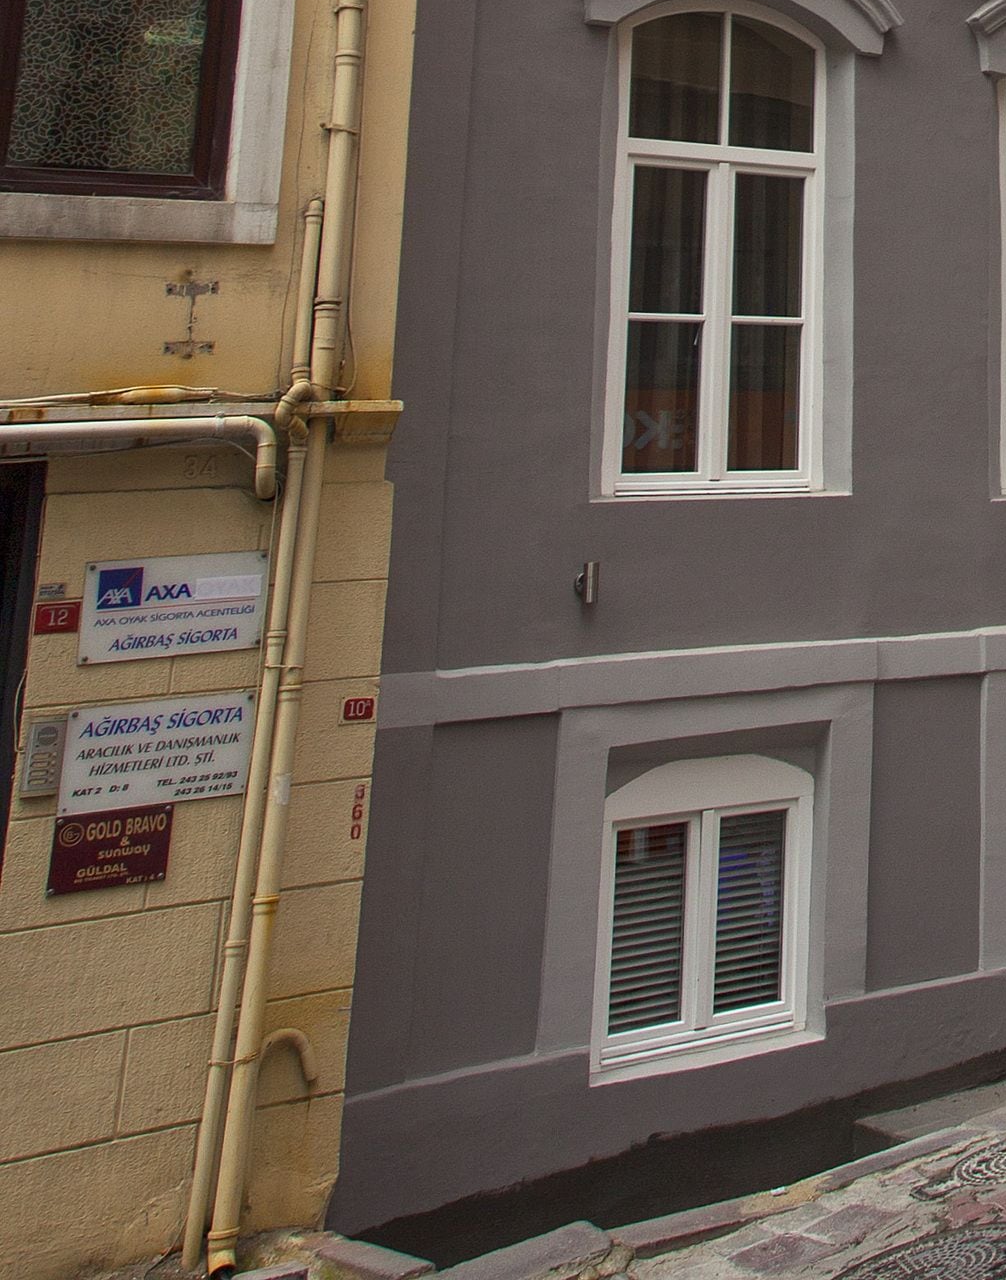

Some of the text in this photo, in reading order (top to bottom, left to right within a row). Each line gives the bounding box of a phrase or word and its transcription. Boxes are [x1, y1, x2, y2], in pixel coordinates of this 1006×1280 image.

[97, 587, 133, 605] AXA
[145, 583, 192, 602] AXA
[48, 609, 69, 626] 12
[94, 605, 256, 628] AXA OYAK SİGORTA ACENTELİĞİ
[108, 628, 238, 653] AĞIRBAŞ SİGORTA
[79, 706, 243, 740] AĞIRBAŞ SİGORTA
[76, 732, 242, 760] ARACILIK VE DANIŞMANLIK
[88, 749, 215, 777] HİZMETLERİ LTD. ŞTİ.
[72, 787, 94, 798] KAT
[94, 786, 103, 795] 2
[86, 813, 167, 841] GOLD BRAVO
[120, 836, 131, 846] &
[76, 862, 128, 878] GÜLDAL
